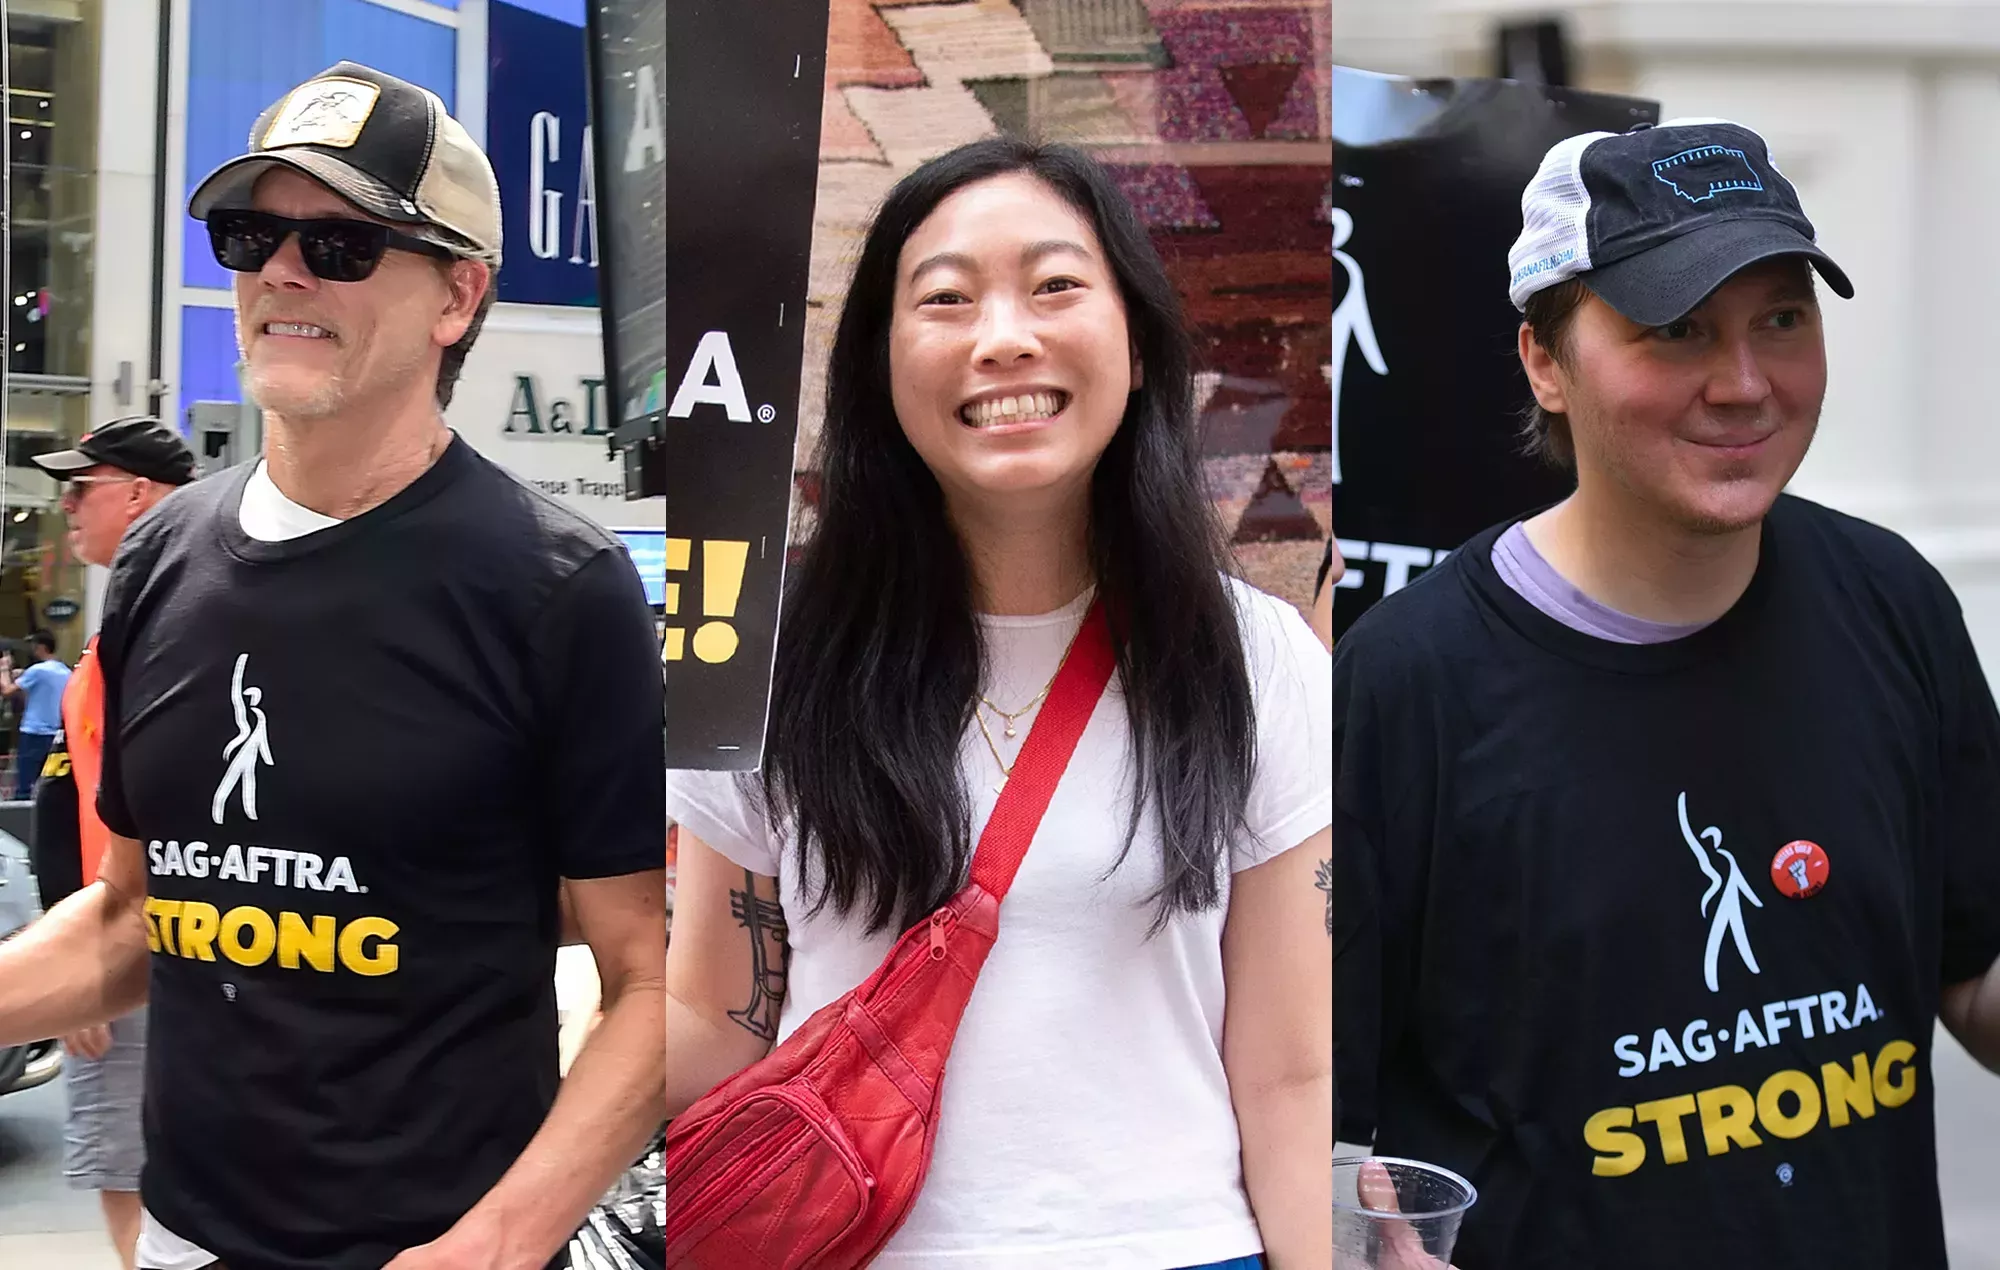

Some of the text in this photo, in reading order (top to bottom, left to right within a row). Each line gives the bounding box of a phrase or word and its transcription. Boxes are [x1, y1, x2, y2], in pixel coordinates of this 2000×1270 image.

[529, 110, 600, 268] GA
[1332, 538, 1454, 608] FT
[143, 896, 400, 976] STRONG
[1583, 1039, 1917, 1177] STRONG
